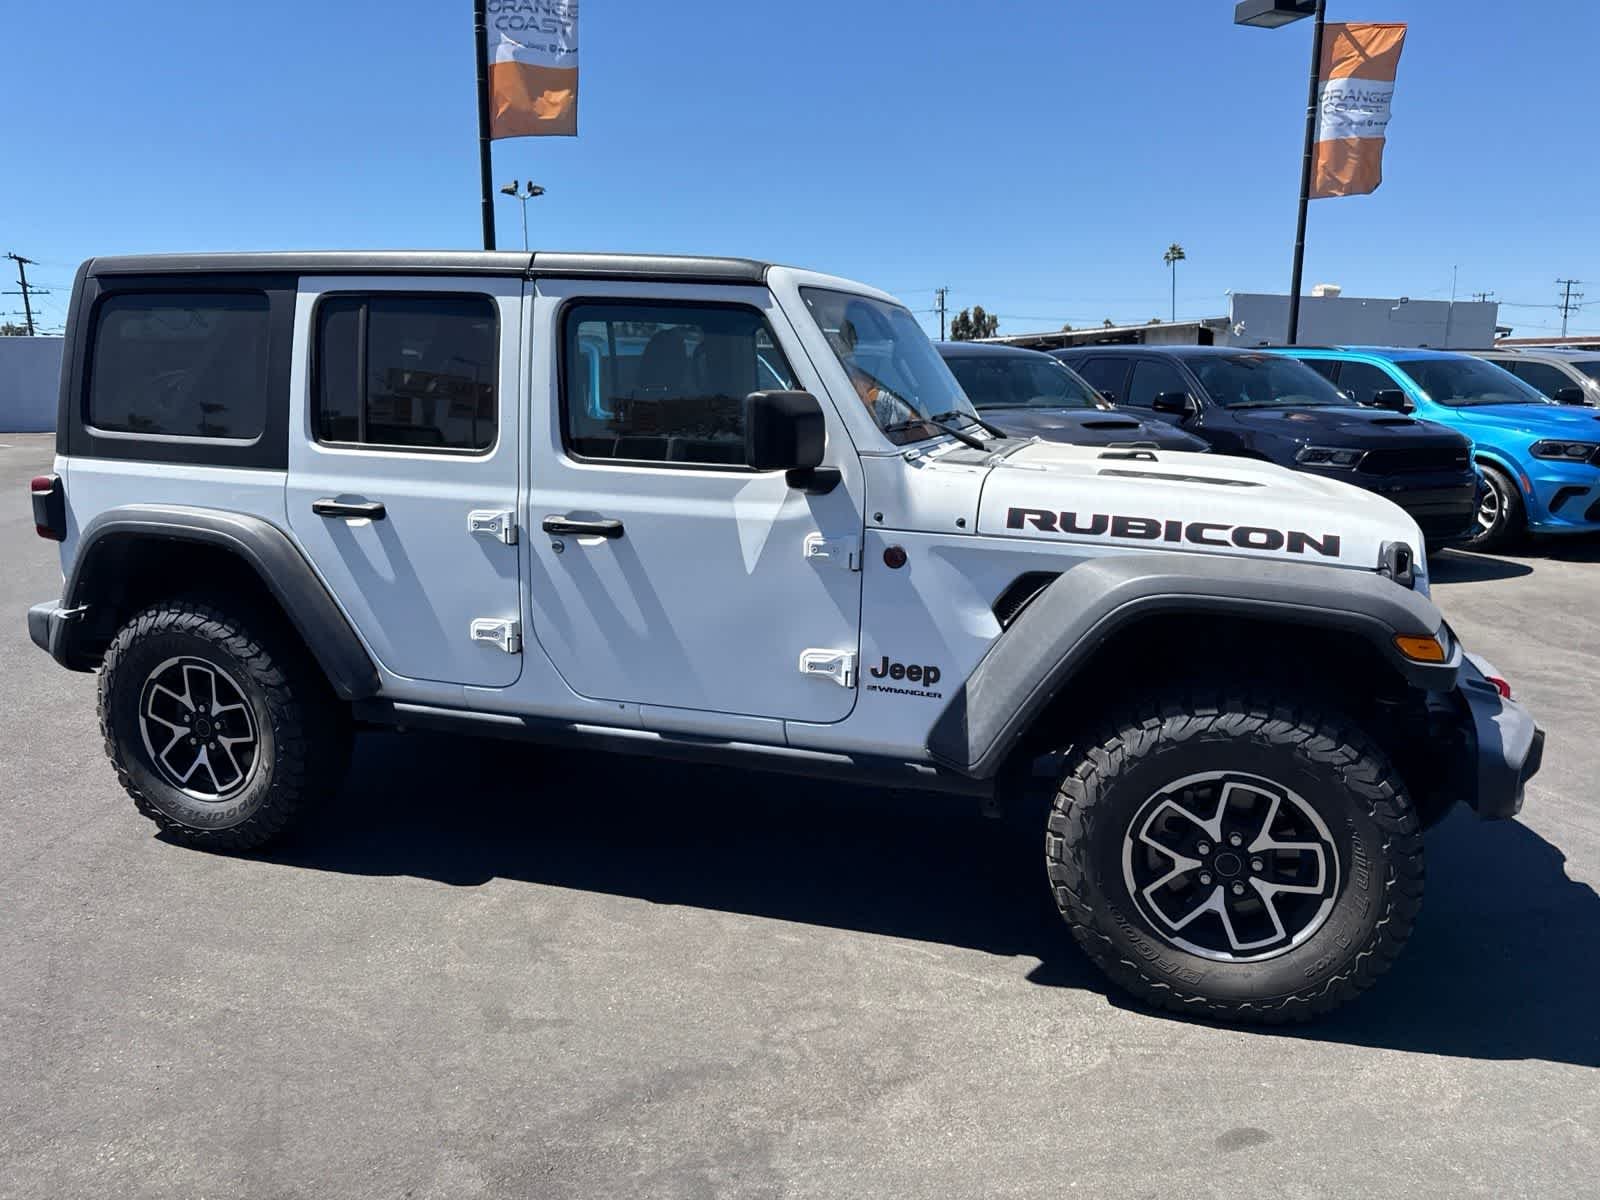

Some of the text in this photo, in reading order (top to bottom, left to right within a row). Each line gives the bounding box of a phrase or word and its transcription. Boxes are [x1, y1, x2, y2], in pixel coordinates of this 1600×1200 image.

[495, 15, 572, 36] COAST
[1006, 507, 1341, 558] RUBICON
[870, 656, 941, 687] Jeep
[879, 686, 942, 698] WRANGLER
